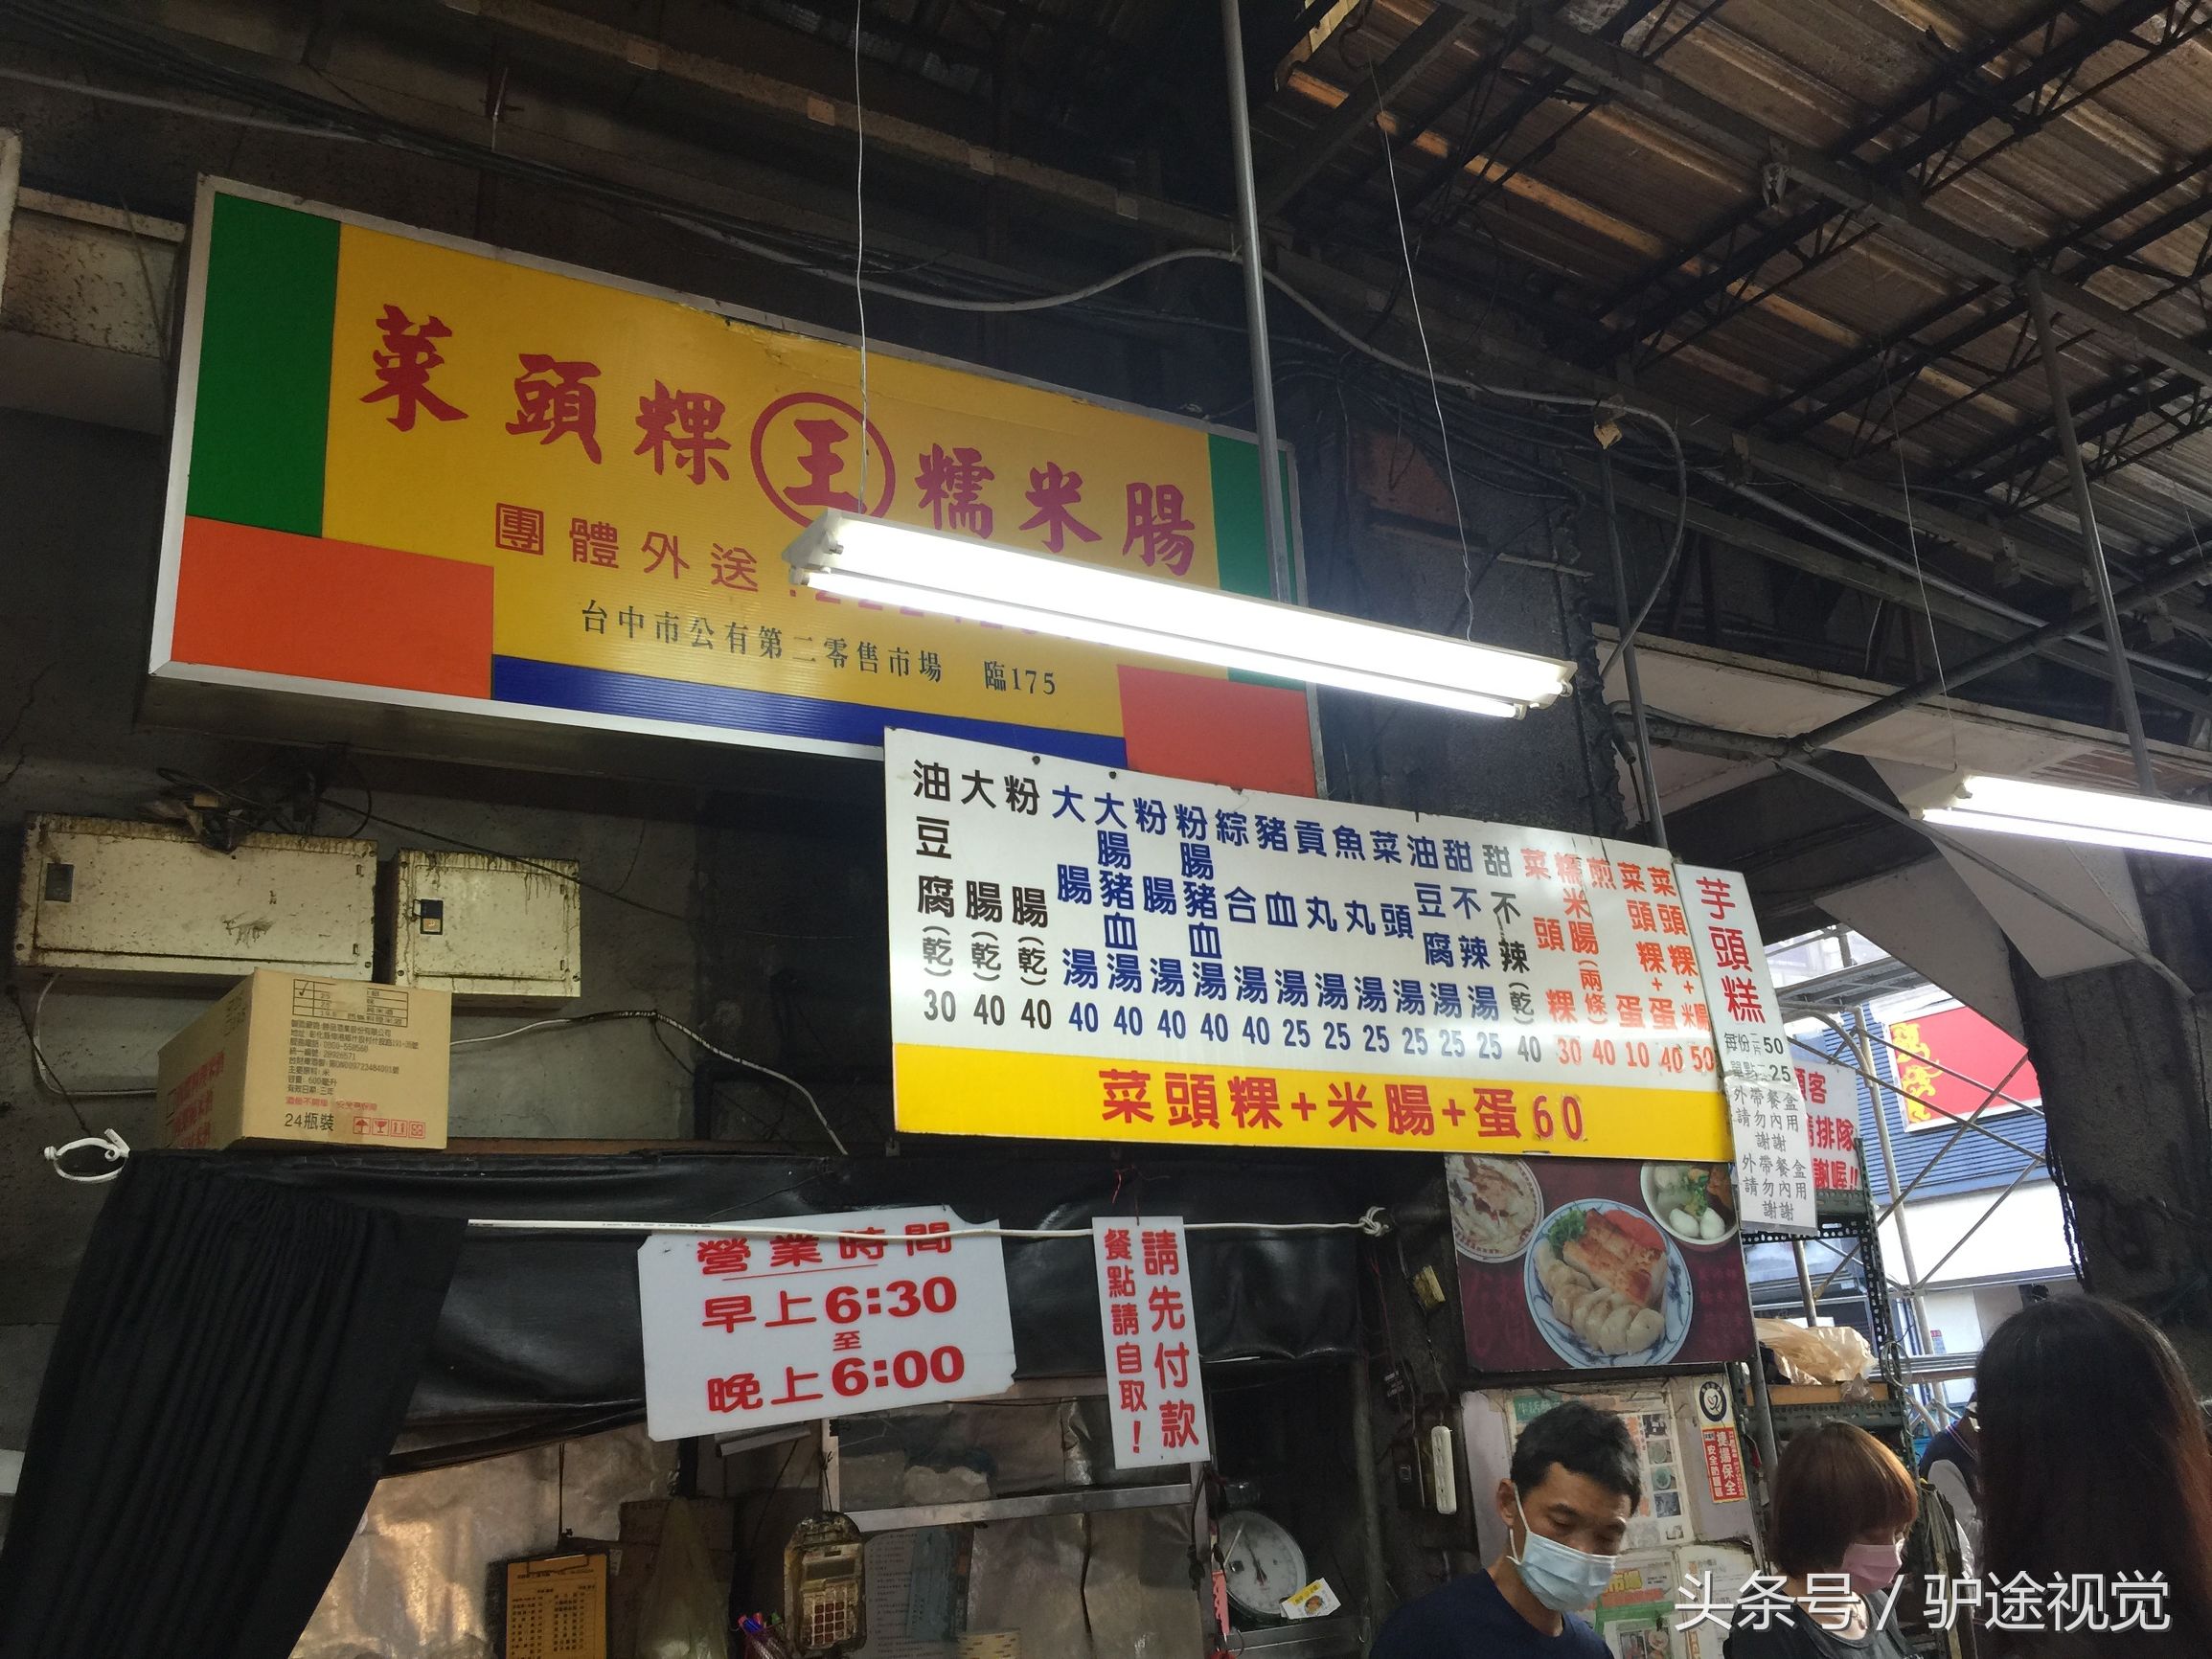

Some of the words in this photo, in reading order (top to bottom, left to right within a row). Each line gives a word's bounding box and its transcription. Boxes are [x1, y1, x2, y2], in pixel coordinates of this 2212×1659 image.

[914, 443, 1196, 577] 糯米腸
[495, 503, 759, 593] 團體外送
[582, 599, 942, 684] 台中市公有第二零售市場
[984, 660, 1057, 695] 臨175
[1696, 876, 1766, 1025] 芋頭糕
[924, 989, 956, 1022] 30
[973, 994, 1005, 1026] 40
[1021, 999, 1052, 1030] 40
[1069, 1002, 1099, 1033] 40
[1113, 1006, 1143, 1036] 40
[1157, 1010, 1186, 1039] 40
[1200, 1012, 1228, 1042] 40
[1243, 1016, 1269, 1045] 40
[1283, 1019, 1310, 1048] 25
[1324, 1022, 1351, 1050] 25
[1363, 1025, 1389, 1053] 25
[1402, 1027, 1428, 1056] 25
[1439, 1030, 1465, 1057] 25
[1478, 1032, 1502, 1059] 25
[1517, 1035, 1541, 1063] 40
[1764, 1036, 1784, 1055] 50
[1557, 1037, 1582, 1065] 30
[1592, 1039, 1616, 1066] 40
[1626, 1041, 1650, 1069] 10
[1660, 1045, 1683, 1073] 40
[1691, 1045, 1715, 1072] 50
[1769, 1064, 1791, 1082] 25
[1734, 1085, 1798, 1112] 外帶餐盒
[285, 1112, 334, 1131] 24瓶裝
[1735, 1107, 1799, 1133] 請勿內用
[1807, 1113, 1856, 1152] 排隊
[1756, 1131, 1787, 1153] 謝謝
[1742, 1153, 1807, 1181] 外帶餐盒
[1744, 1175, 1807, 1200] 請勿內用
[1763, 1201, 1794, 1222] 謝謝
[697, 1221, 951, 1277] 營業時間
[832, 1330, 862, 1352] 至
[1104, 1227, 1148, 1454] 餐點請自取!
[1141, 1230, 1199, 1450] 請先付款
